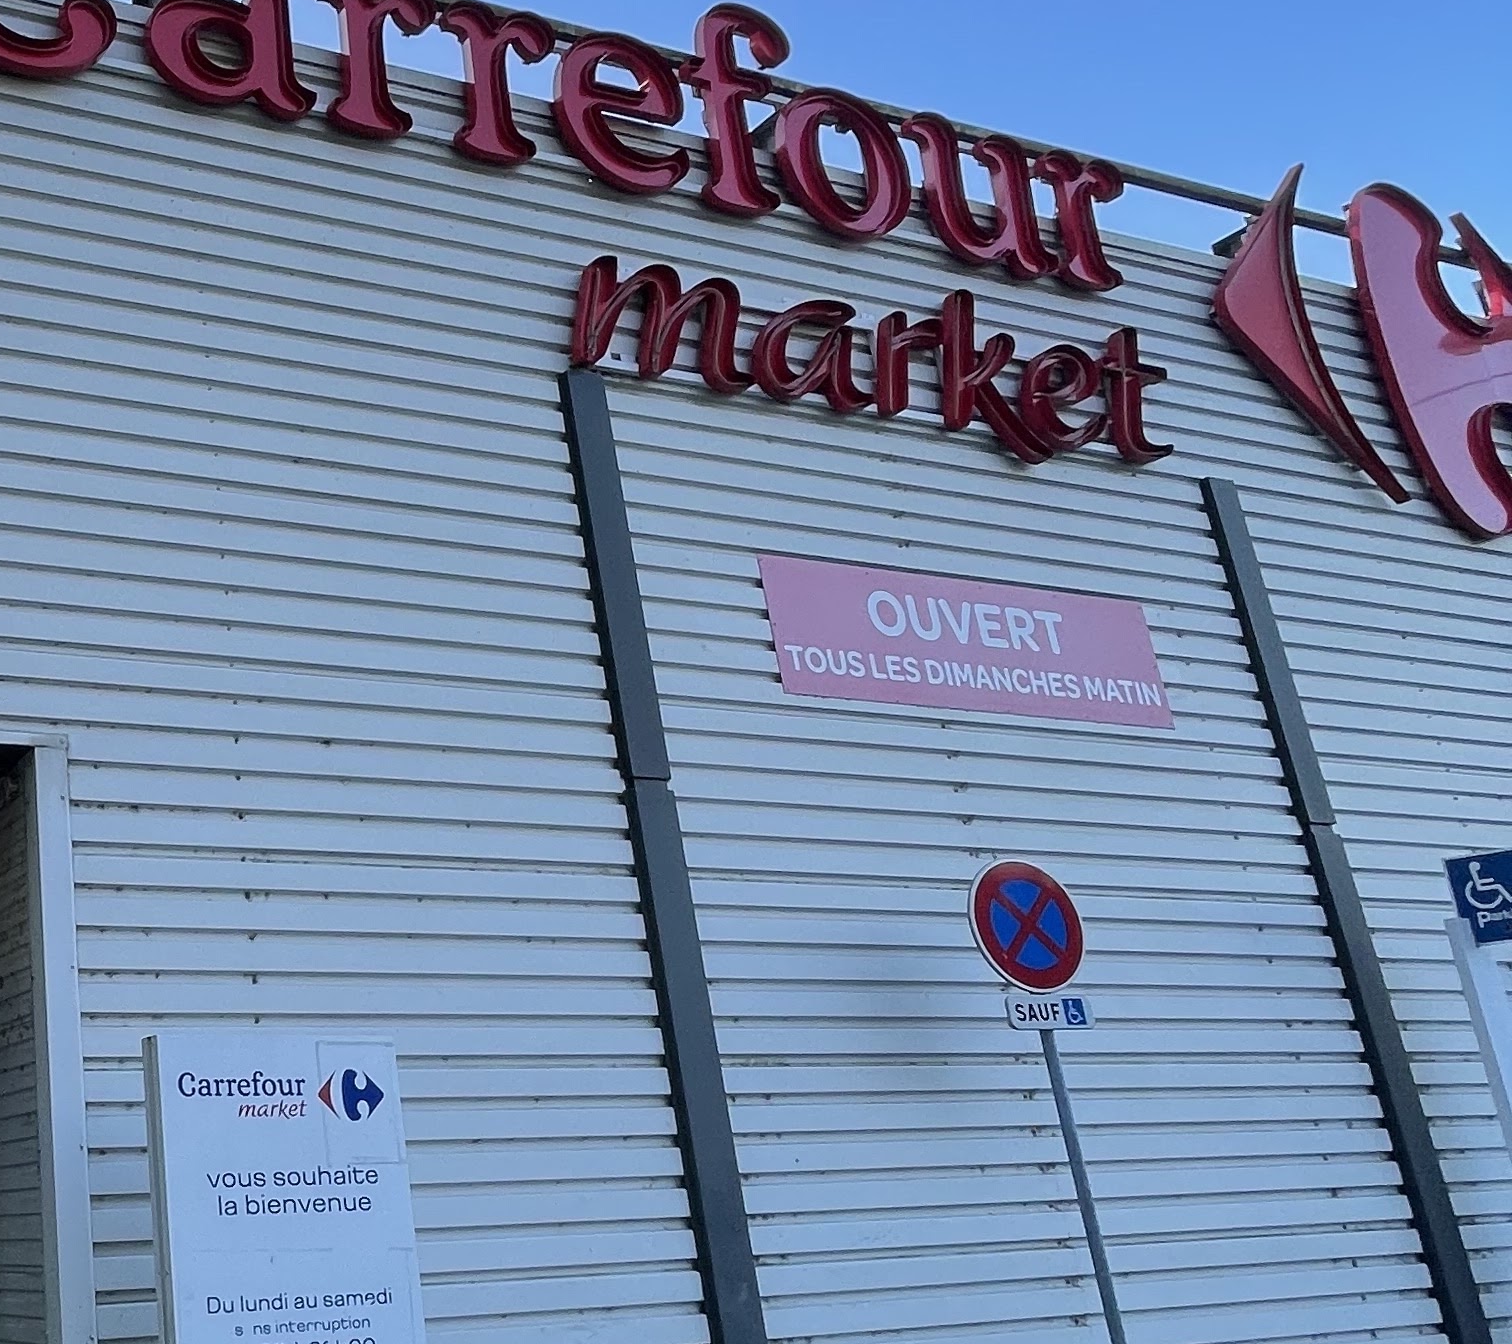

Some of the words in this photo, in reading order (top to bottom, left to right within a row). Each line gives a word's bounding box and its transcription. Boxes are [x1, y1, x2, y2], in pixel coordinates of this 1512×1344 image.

[571, 255, 1174, 464] market
[866, 590, 1063, 655] OUVERT
[784, 644, 866, 678] TOUS
[869, 654, 921, 683] LES
[925, 659, 1081, 700] DIMANCHES
[1083, 676, 1162, 707] MATIN
[1014, 1002, 1060, 1022] SAUF
[177, 1070, 306, 1097] Carrefour
[238, 1099, 308, 1119] market
[206, 1171, 266, 1188] vous
[273, 1164, 379, 1187] souhaite
[217, 1195, 238, 1216] la
[245, 1194, 372, 1215] bienvenue
[206, 1296, 234, 1314] Du
[240, 1292, 288, 1312] lundi
[293, 1295, 317, 1310] au
[323, 1287, 393, 1307] samedi
[234, 1323, 271, 1337] sns
[275, 1315, 371, 1334] interruption
